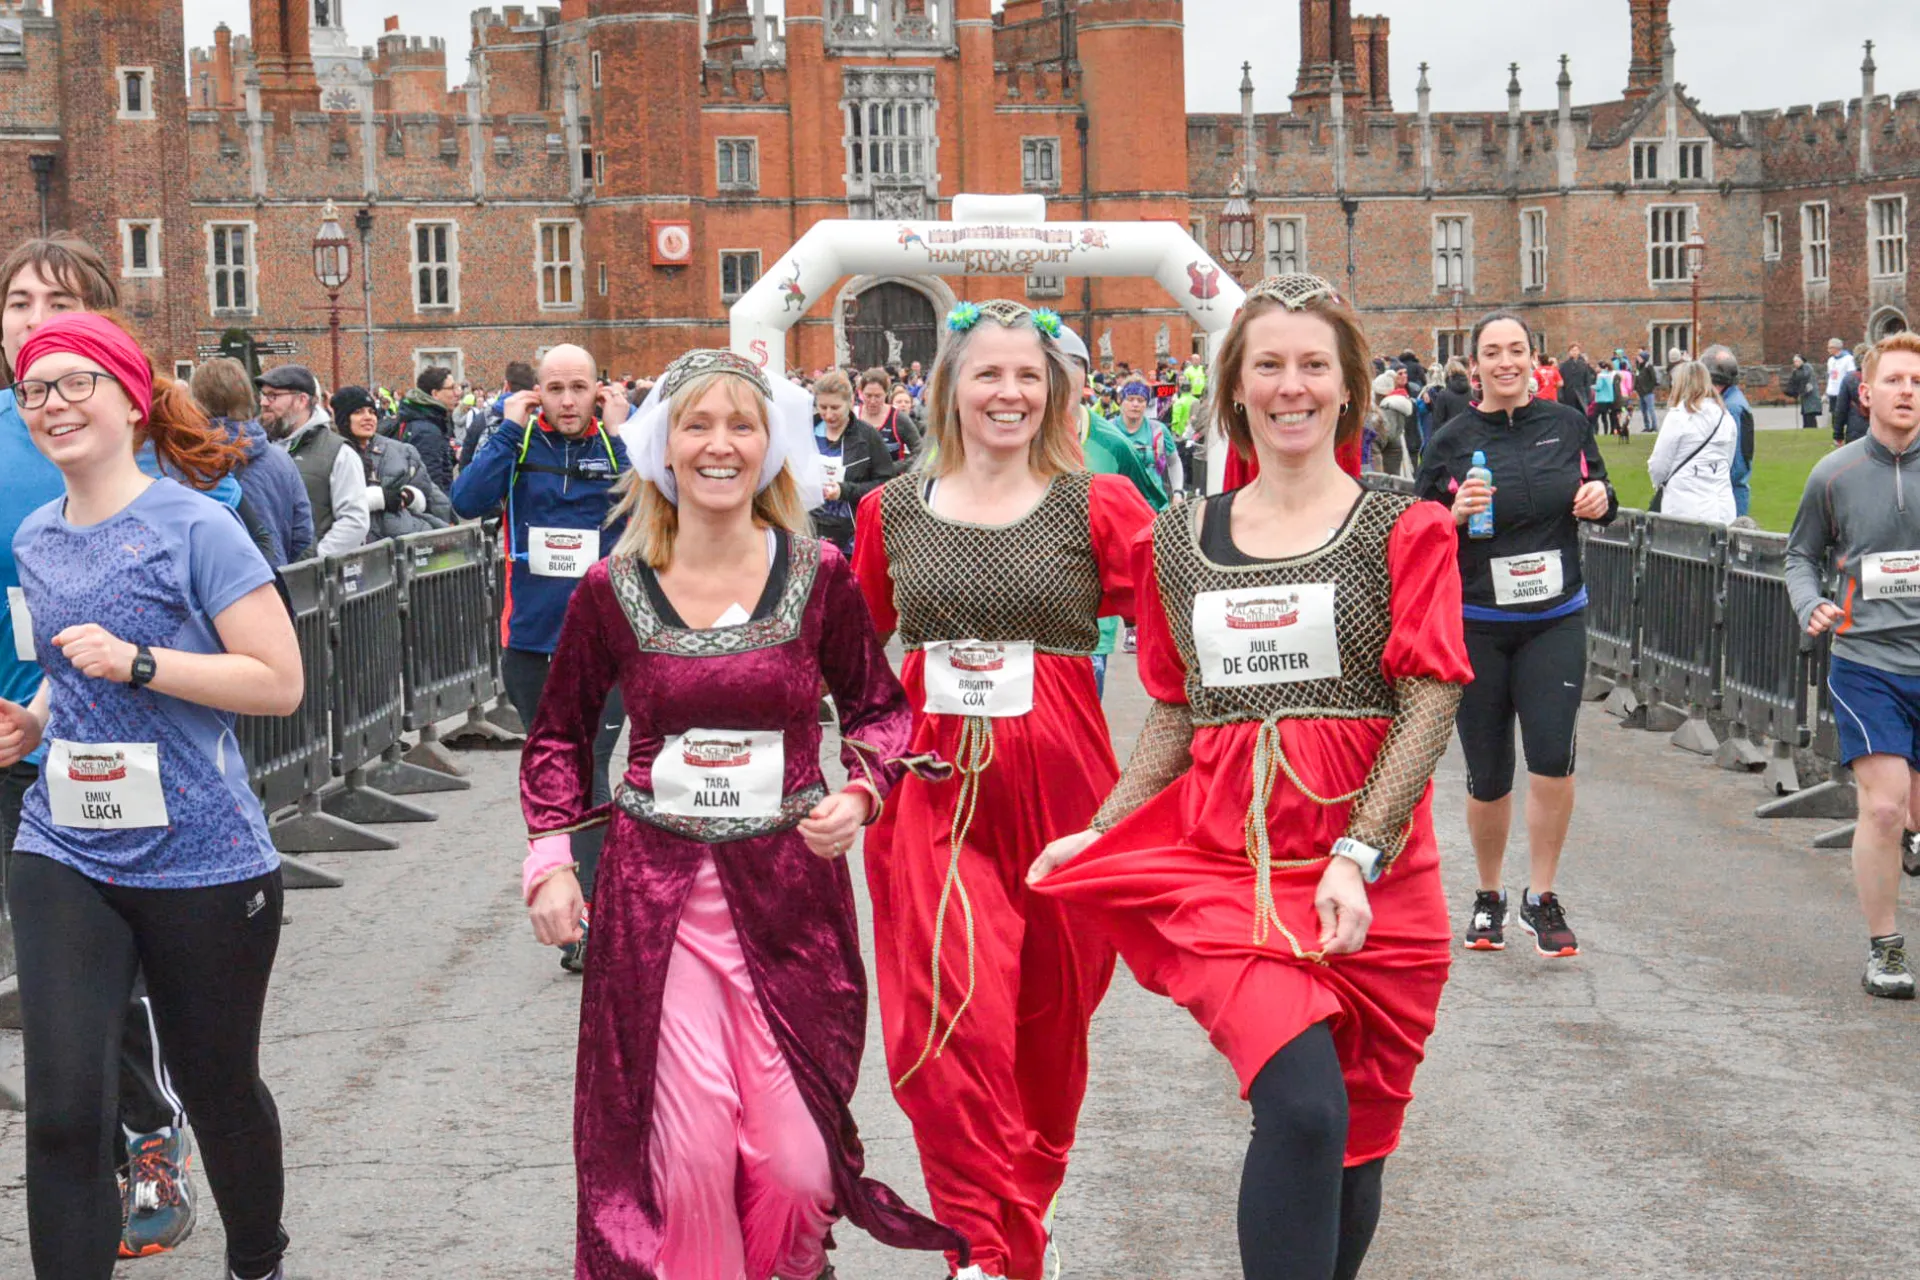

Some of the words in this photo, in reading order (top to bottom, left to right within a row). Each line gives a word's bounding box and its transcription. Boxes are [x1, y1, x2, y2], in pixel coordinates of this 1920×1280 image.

[928, 249, 1010, 262] HAMPTON
[1016, 249, 1071, 262] COURT
[964, 261, 1035, 274] PALACE
[548, 561, 577, 571] BLIGHT
[1512, 585, 1549, 598] SANDERS
[1249, 639, 1278, 653] JULIE
[1223, 657, 1243, 674] DE
[1246, 652, 1310, 672] GORTER
[958, 679, 995, 690] BRIGITTE
[962, 692, 986, 706] COX
[703, 777, 731, 789] TARA
[85, 791, 112, 803] EMILY
[693, 790, 740, 807] ALLAN
[81, 804, 122, 820] LEACH
